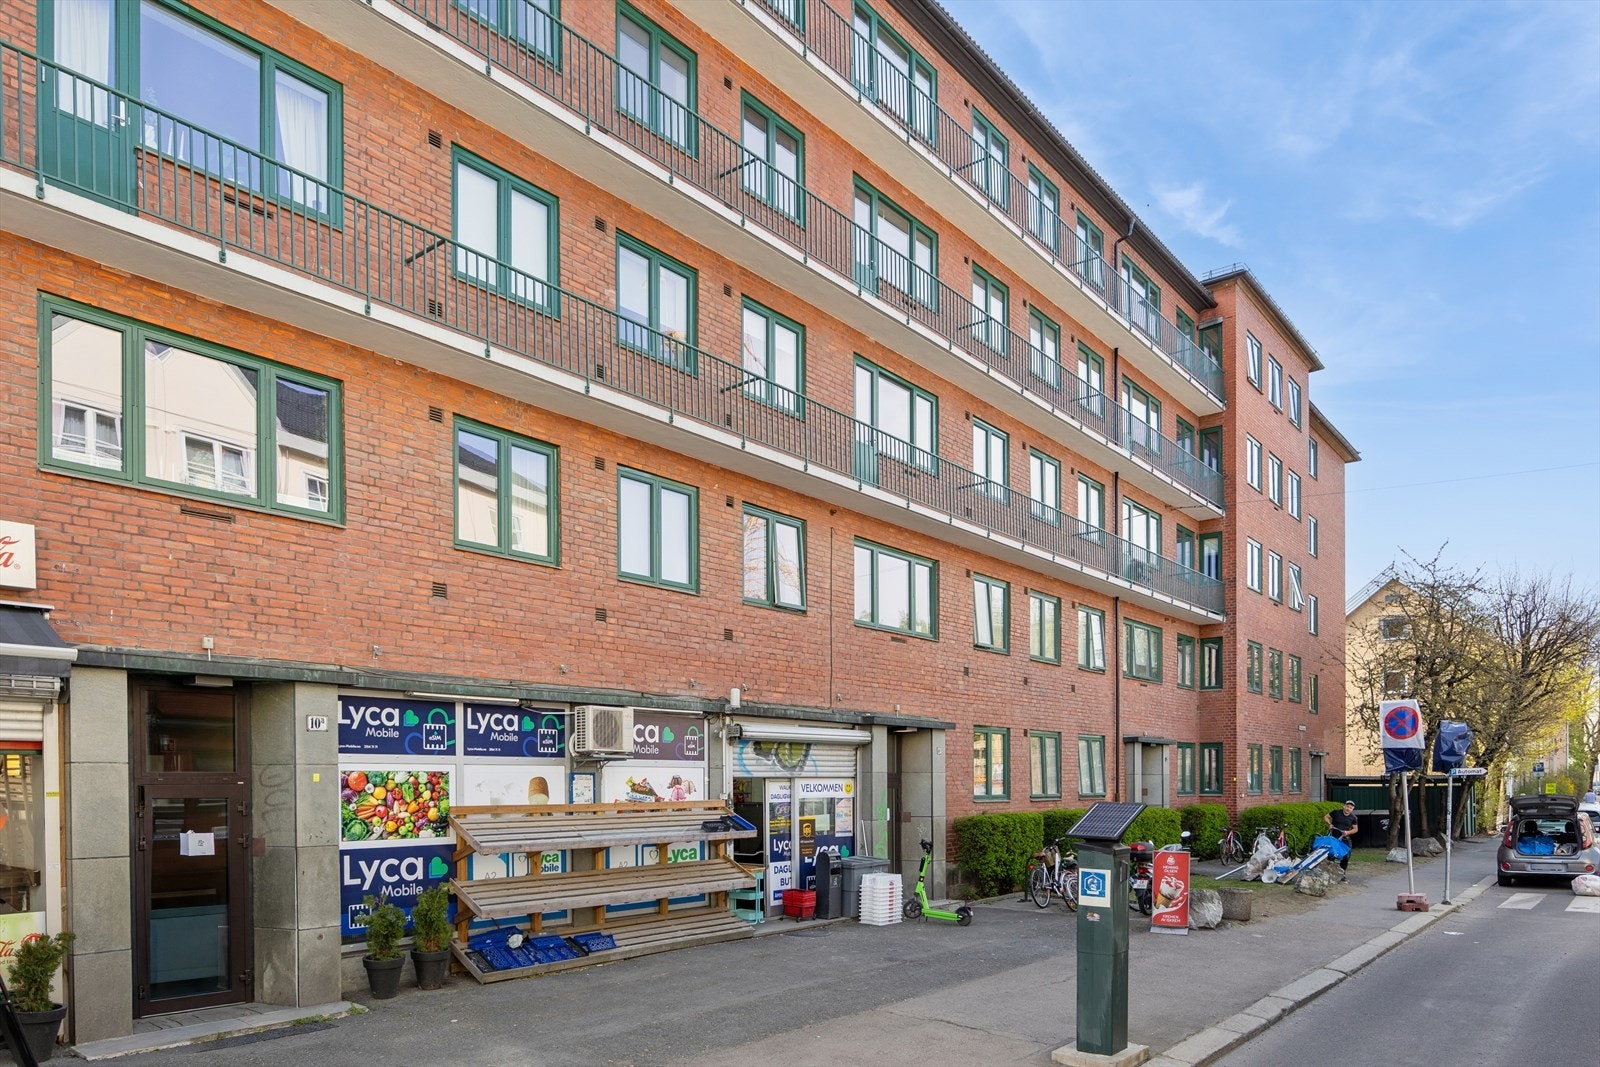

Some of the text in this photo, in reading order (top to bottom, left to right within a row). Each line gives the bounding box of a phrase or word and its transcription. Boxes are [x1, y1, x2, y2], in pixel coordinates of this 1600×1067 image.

[338, 700, 400, 729] Lyca
[467, 707, 518, 734] Lyca
[365, 727, 400, 738] Mobile
[490, 731, 518, 742] Mobile
[633, 723, 659, 743] ca
[633, 744, 659, 755] Mobile
[801, 783, 843, 793] VELKOMMEN
[540, 853, 559, 865] yca
[343, 855, 423, 891] Lyca
[381, 883, 423, 897] Mobile
